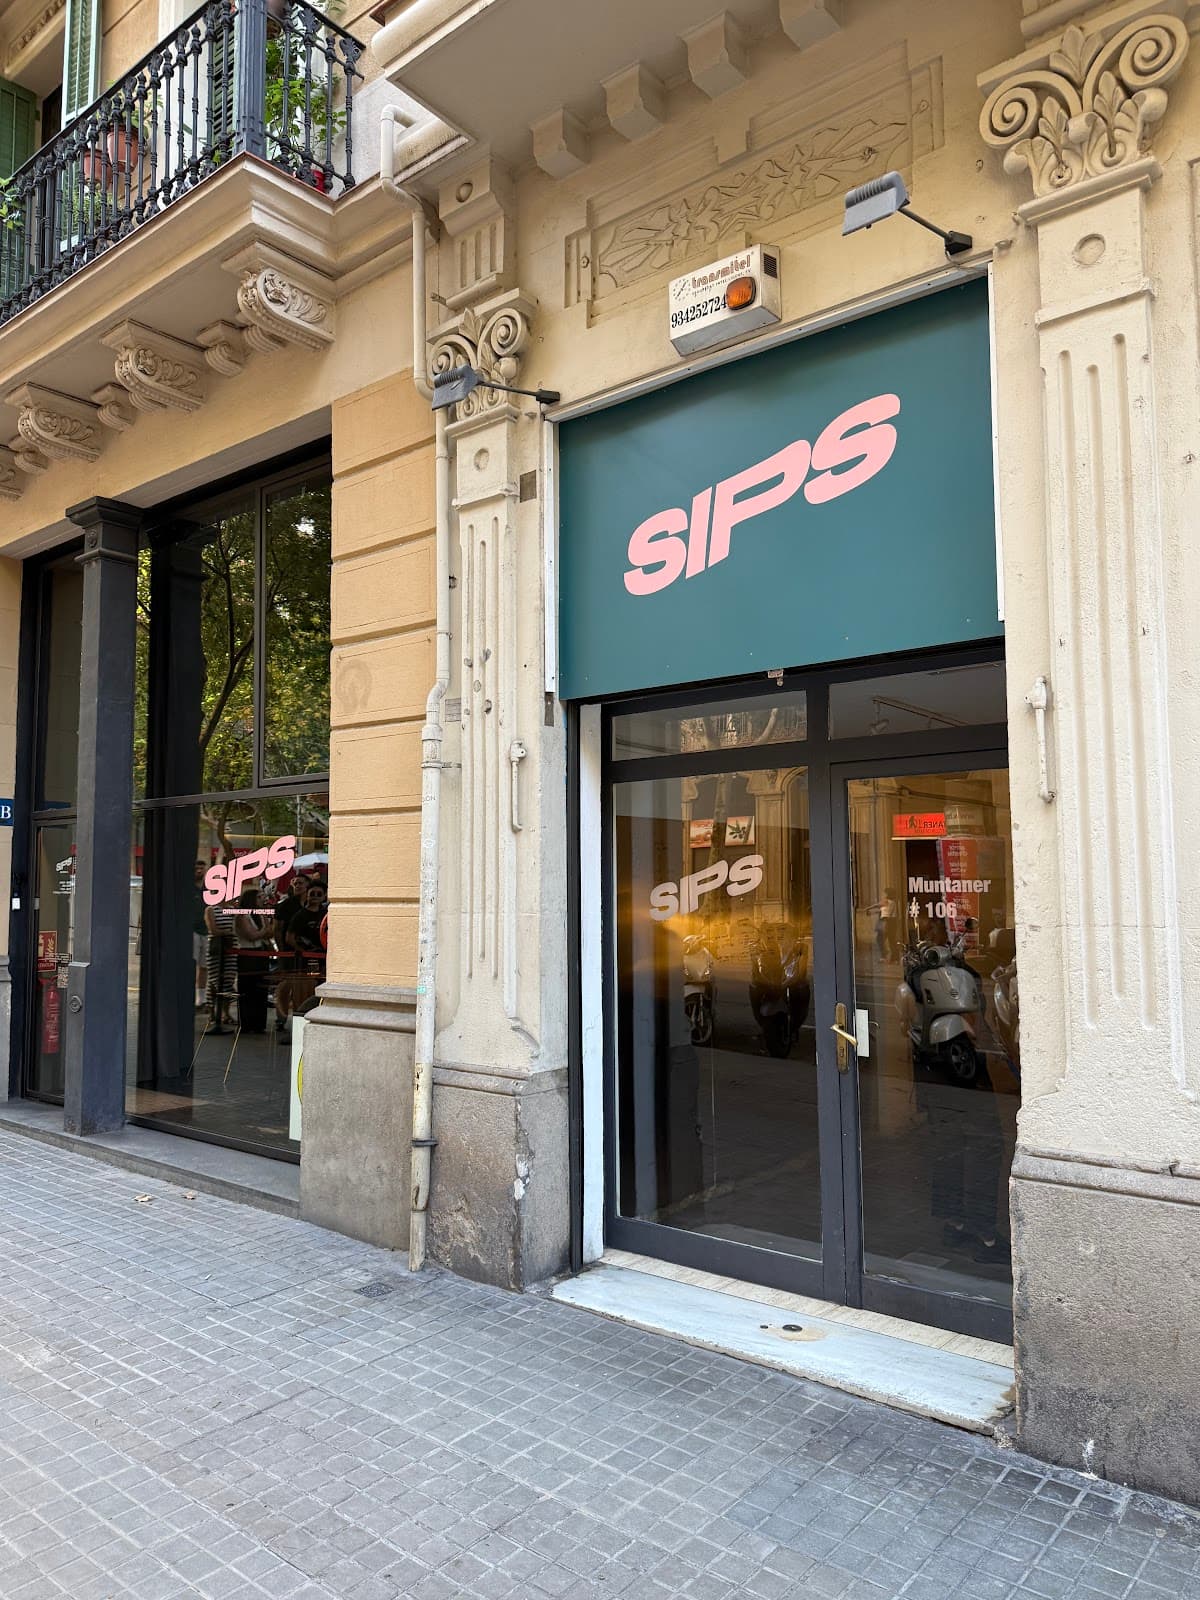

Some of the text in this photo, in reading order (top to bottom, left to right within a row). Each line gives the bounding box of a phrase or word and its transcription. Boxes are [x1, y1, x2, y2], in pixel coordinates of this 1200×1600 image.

[691, 254, 751, 289] transmitel
[671, 293, 727, 328] 934252724
[623, 393, 901, 596] SIPS
[203, 835, 296, 906] SIPS
[649, 854, 764, 921] SIPS
[908, 877, 991, 893] Muntaner
[925, 902, 957, 918] 106
